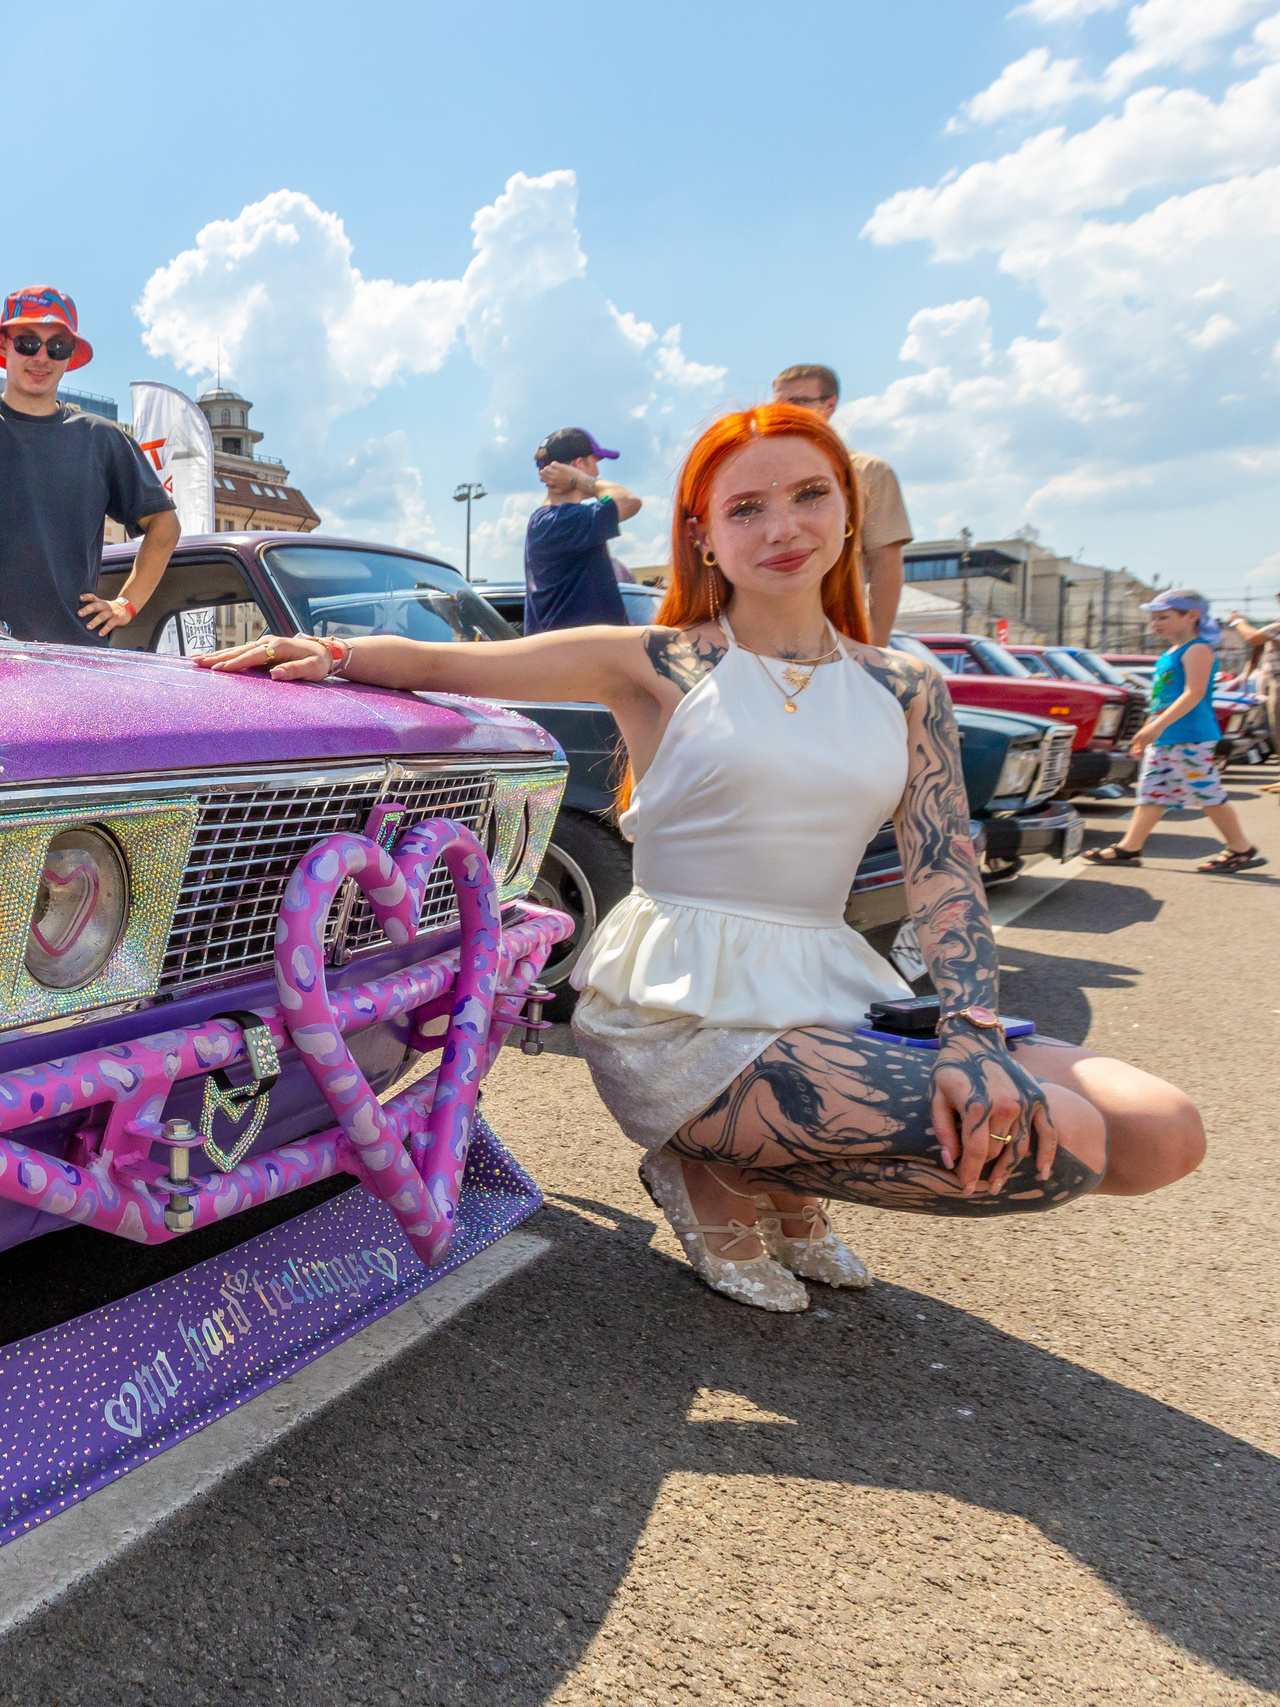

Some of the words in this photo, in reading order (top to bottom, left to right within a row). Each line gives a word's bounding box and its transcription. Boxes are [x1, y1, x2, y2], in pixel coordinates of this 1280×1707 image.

[134, 1349, 181, 1416] no
[177, 1287, 253, 1374] hard
[251, 1253, 371, 1318] feelings
